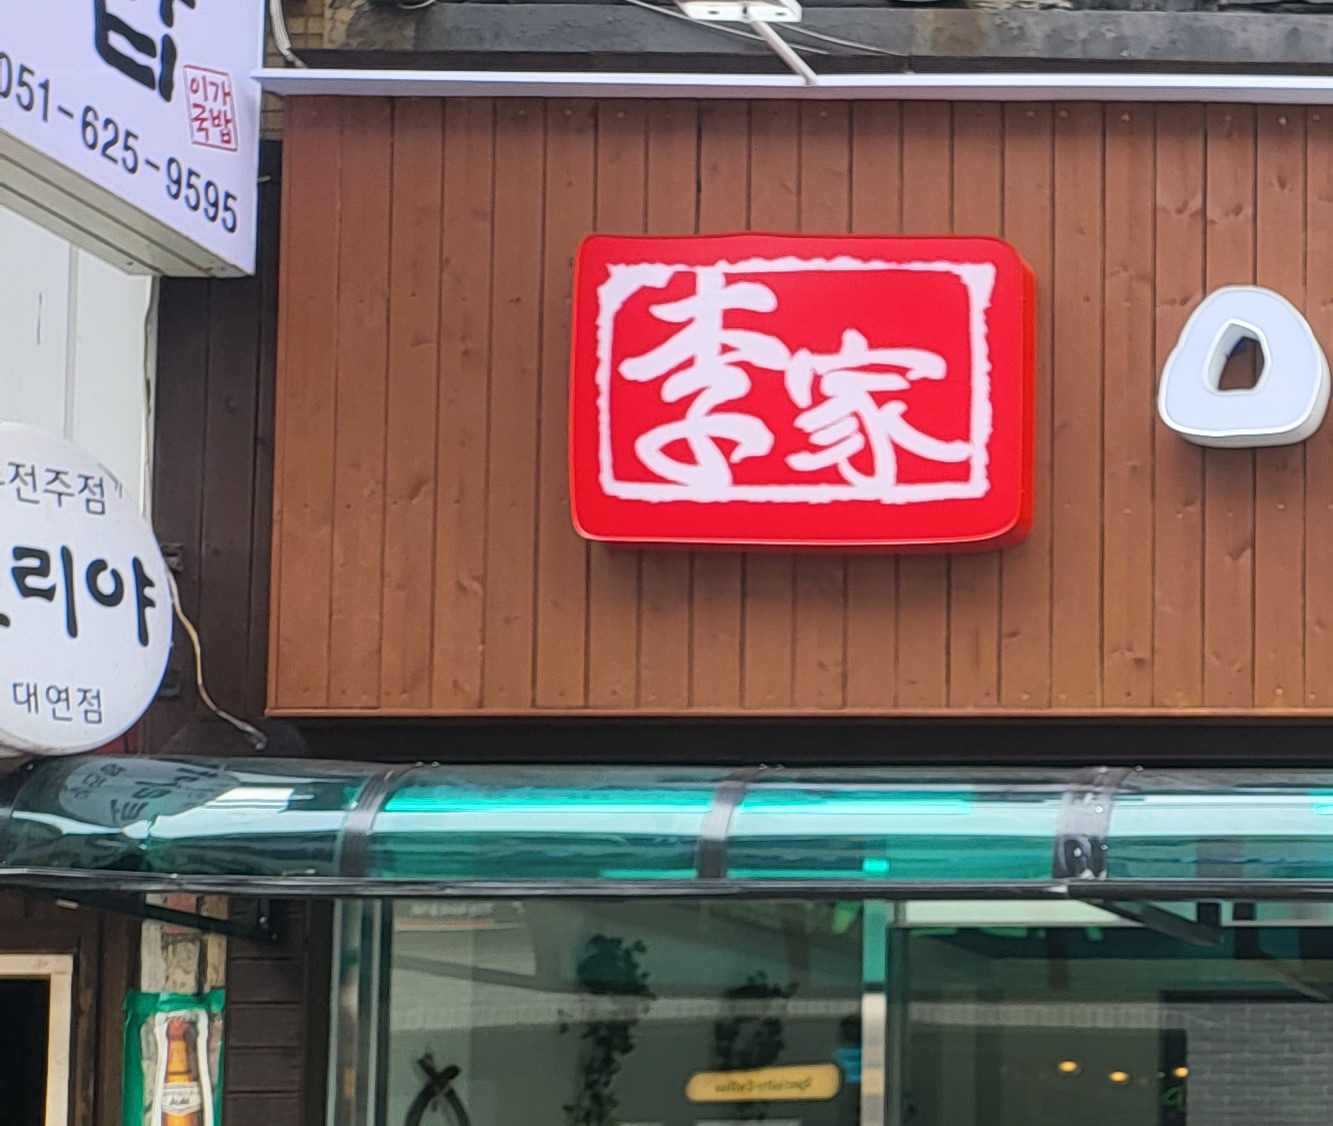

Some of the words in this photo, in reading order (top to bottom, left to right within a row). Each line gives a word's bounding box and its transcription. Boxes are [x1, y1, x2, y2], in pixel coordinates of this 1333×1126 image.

[0, 461, 107, 516] 전주점
[0, 545, 156, 647] 리야
[12, 681, 103, 725] 대연점
